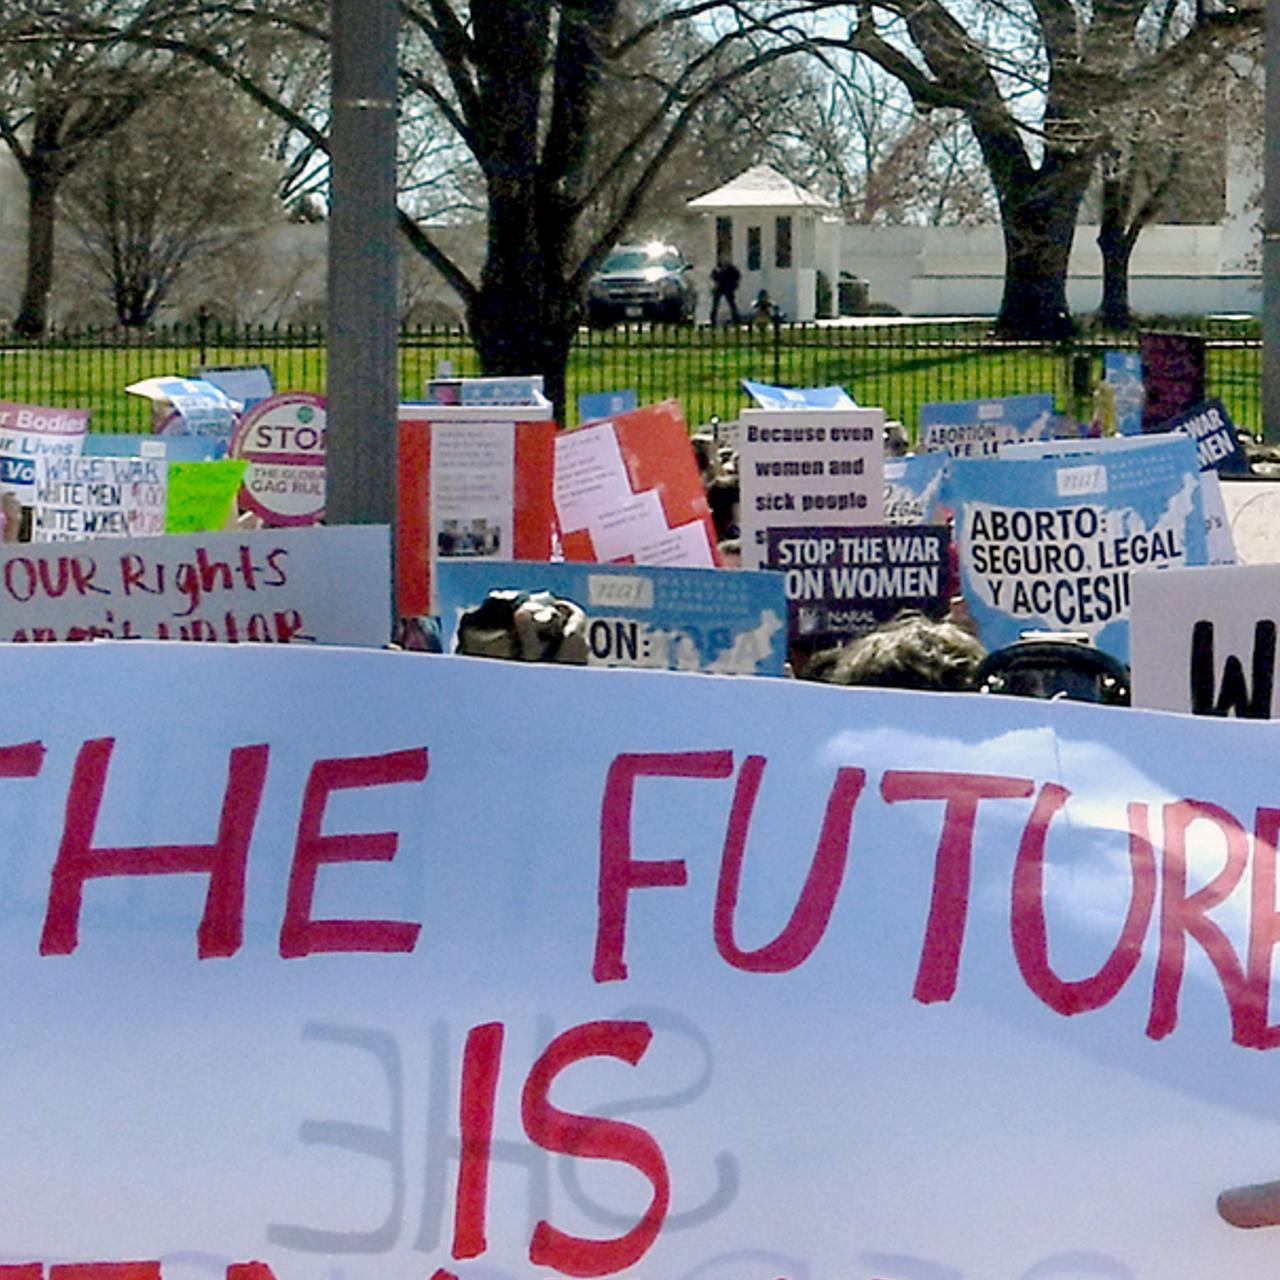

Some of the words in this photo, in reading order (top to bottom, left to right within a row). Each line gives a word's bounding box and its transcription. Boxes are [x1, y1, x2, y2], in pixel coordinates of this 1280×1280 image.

[16, 409, 87, 431] Bodies
[746, 425, 826, 443] Because
[830, 426, 874, 443] even
[21, 437, 74, 455] Lives
[755, 460, 825, 477] women
[829, 457, 865, 476] and
[87, 483, 122, 506] MEN
[755, 492, 797, 511] sick
[801, 492, 868, 512] people
[970, 507, 1107, 543] ABORTO:
[778, 538, 837, 565] STOP
[839, 537, 890, 564] THE
[887, 536, 940, 563] WAR
[1098, 529, 1183, 570] LEGAL
[3, 555, 112, 603] OUR
[784, 569, 824, 600] ON
[830, 565, 939, 600] WOMEN
[986, 579, 1003, 606] Y
[0, 736, 430, 958] HE
[451, 1019, 670, 1278] IS
